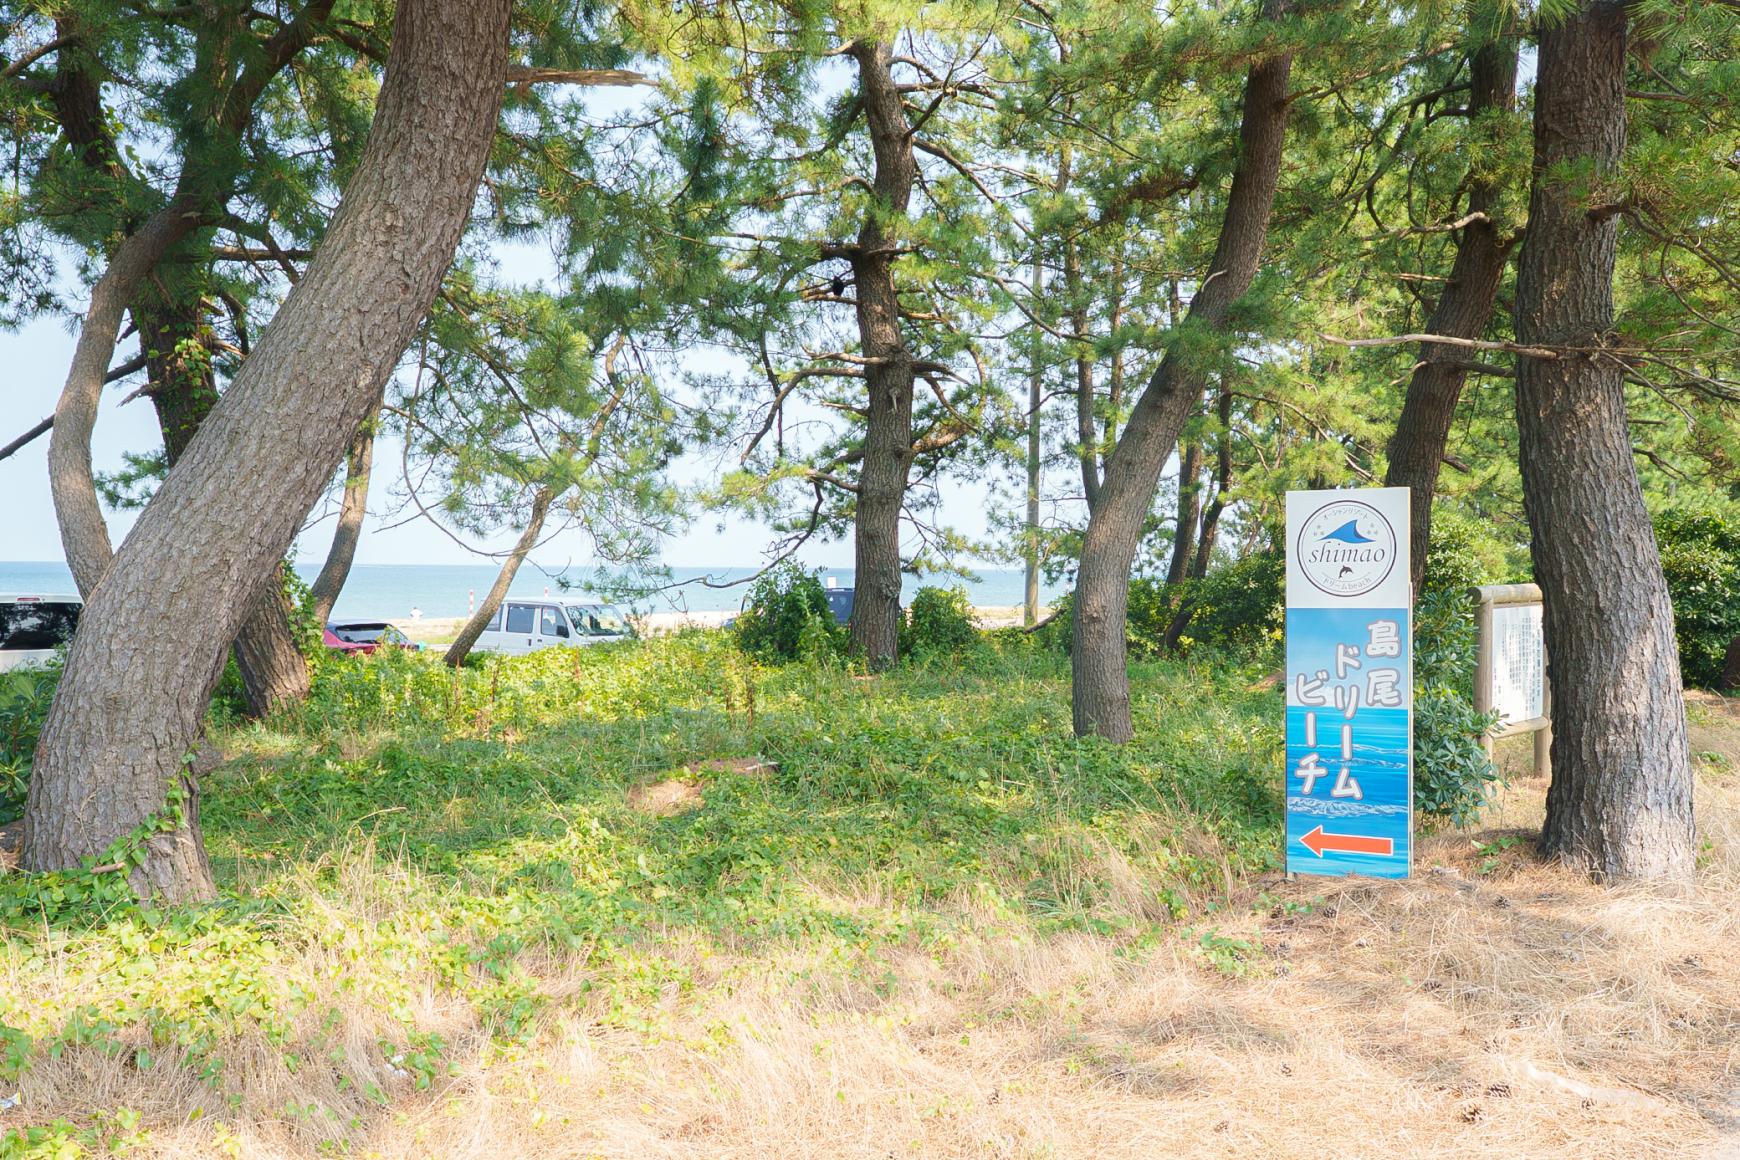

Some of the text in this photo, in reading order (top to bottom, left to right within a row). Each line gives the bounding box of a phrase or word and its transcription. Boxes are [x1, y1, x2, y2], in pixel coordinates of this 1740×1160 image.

[1308, 541, 1385, 563] shimao
[1366, 620, 1402, 706] 島尾
[1295, 670, 1328, 795] ビーチ
[1331, 643, 1363, 800] ドリーム
